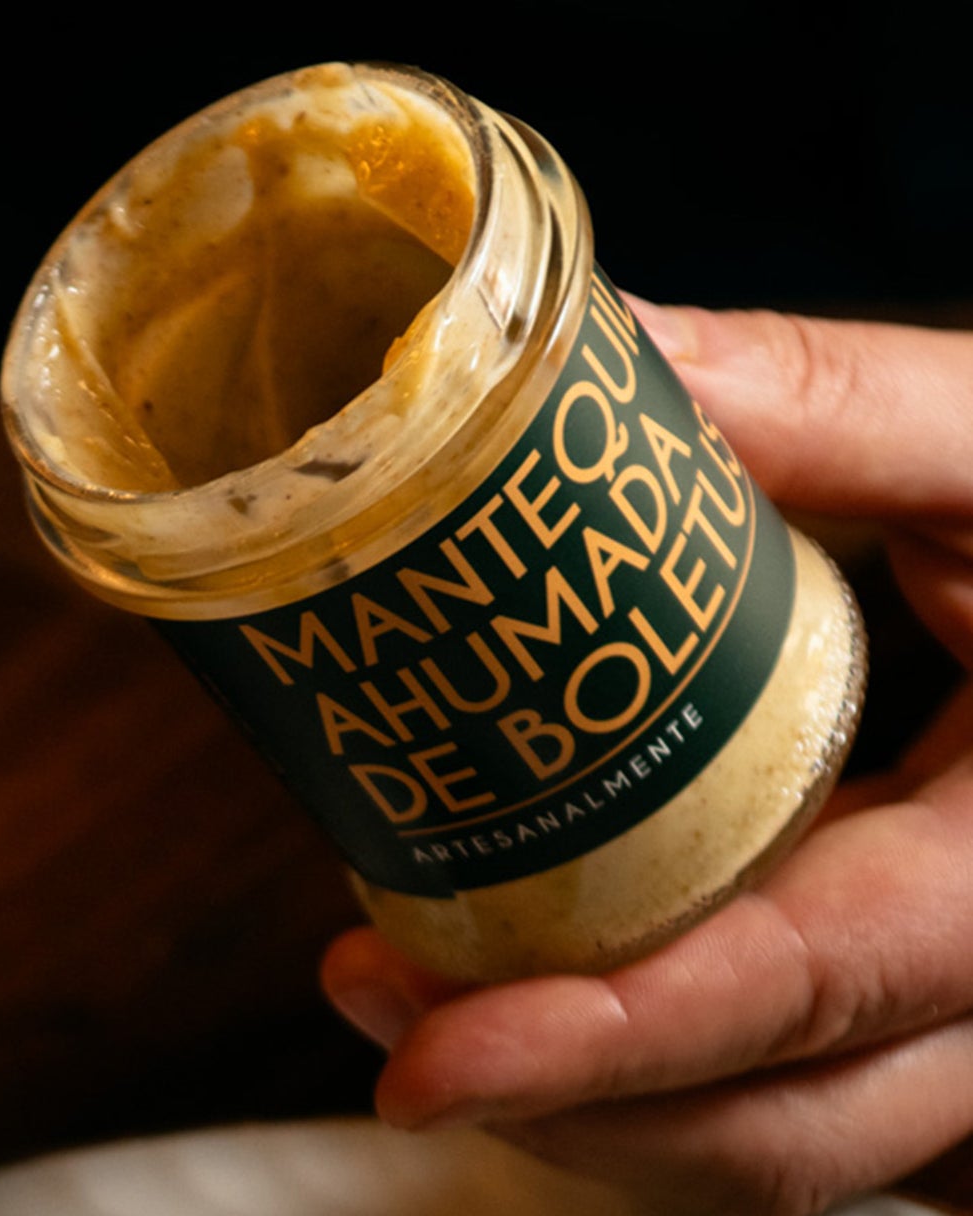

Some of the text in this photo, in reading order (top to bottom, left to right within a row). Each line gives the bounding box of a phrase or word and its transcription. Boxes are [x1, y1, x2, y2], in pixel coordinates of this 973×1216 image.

[315, 413, 692, 756] AHUMADA
[347, 741, 497, 824] DE
[412, 702, 703, 864] ARTESANALMENTE
